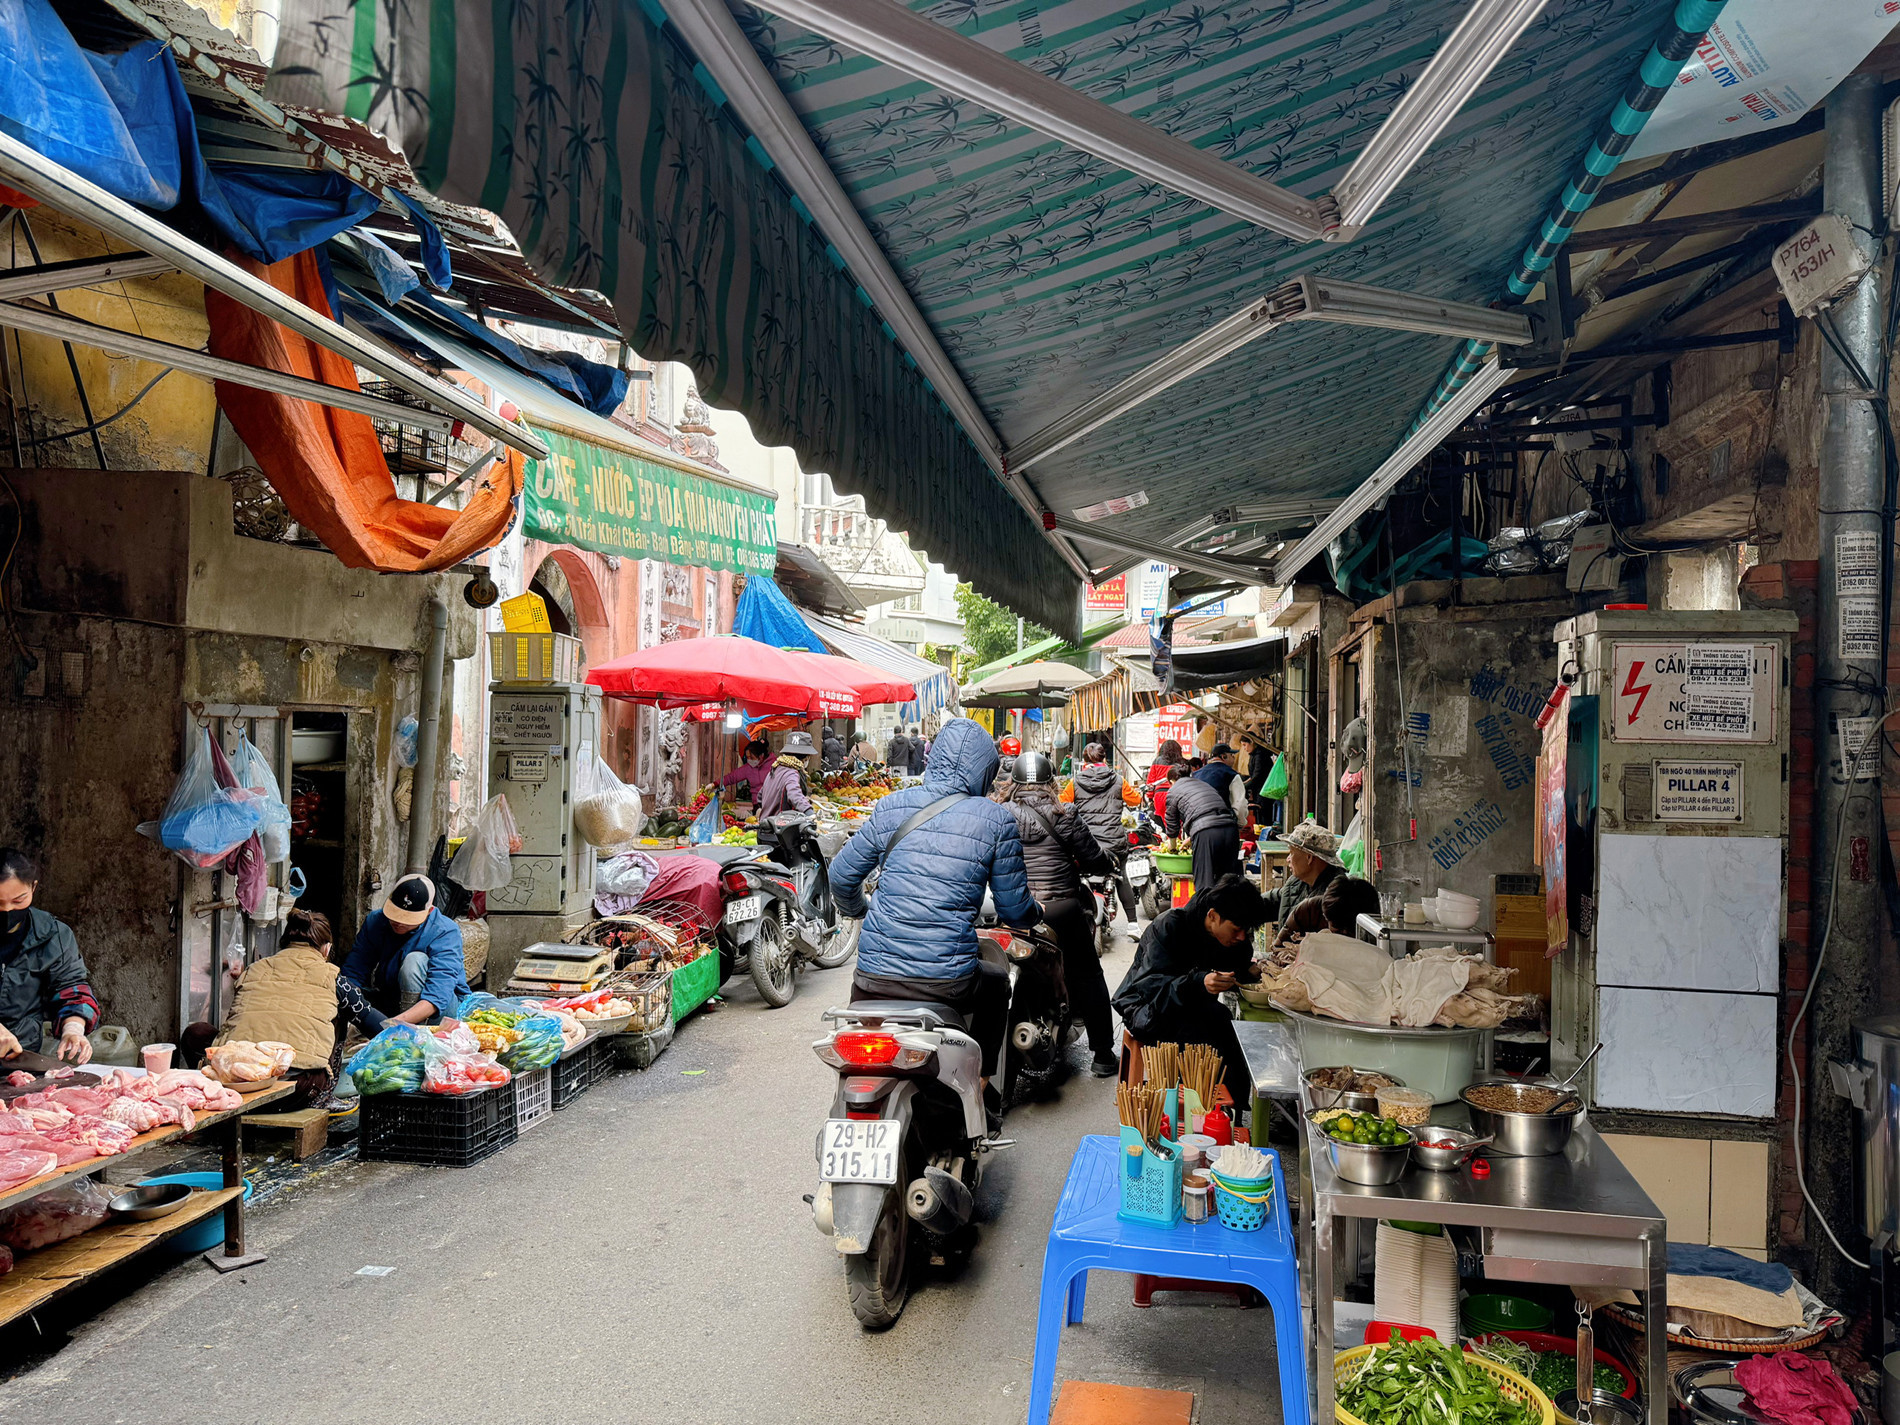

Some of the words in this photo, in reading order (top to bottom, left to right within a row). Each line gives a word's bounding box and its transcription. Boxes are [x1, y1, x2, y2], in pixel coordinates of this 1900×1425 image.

[1738, 93, 1779, 121] ALUTITAN
[1780, 229, 1820, 266] P764
[1790, 243, 1836, 282] 153/H
[592, 462, 635, 519] NƯỚC
[638, 468, 654, 522] ÉP
[656, 482, 685, 529] HOA
[684, 481, 708, 535] QUẢ
[707, 497, 749, 543] NGUYÊN
[749, 500, 776, 548] CHẤT
[710, 542, 723, 562] HN
[1088, 591, 1102, 600] LẤY
[1702, 667, 1716, 676] HÚT
[1726, 668, 1745, 676] PHỐT
[527, 704, 538, 714] LẠI
[1702, 714, 1715, 722] HÚT
[1726, 714, 1744, 723] PHỐT
[513, 729, 531, 738] CHẾT
[1684, 768, 1692, 776] 40
[1668, 779, 1717, 792] PILLAR
[1721, 780, 1730, 792] 4
[1677, 796, 1697, 804] PILLAR
[1454, 817, 1464, 827] B
[1432, 802, 1509, 871] 0912936662
[730, 897, 755, 912] 29-C1
[728, 906, 759, 924] 622.26
[833, 1124, 889, 1149] 29-H2
[824, 1151, 892, 1180] 315.11
